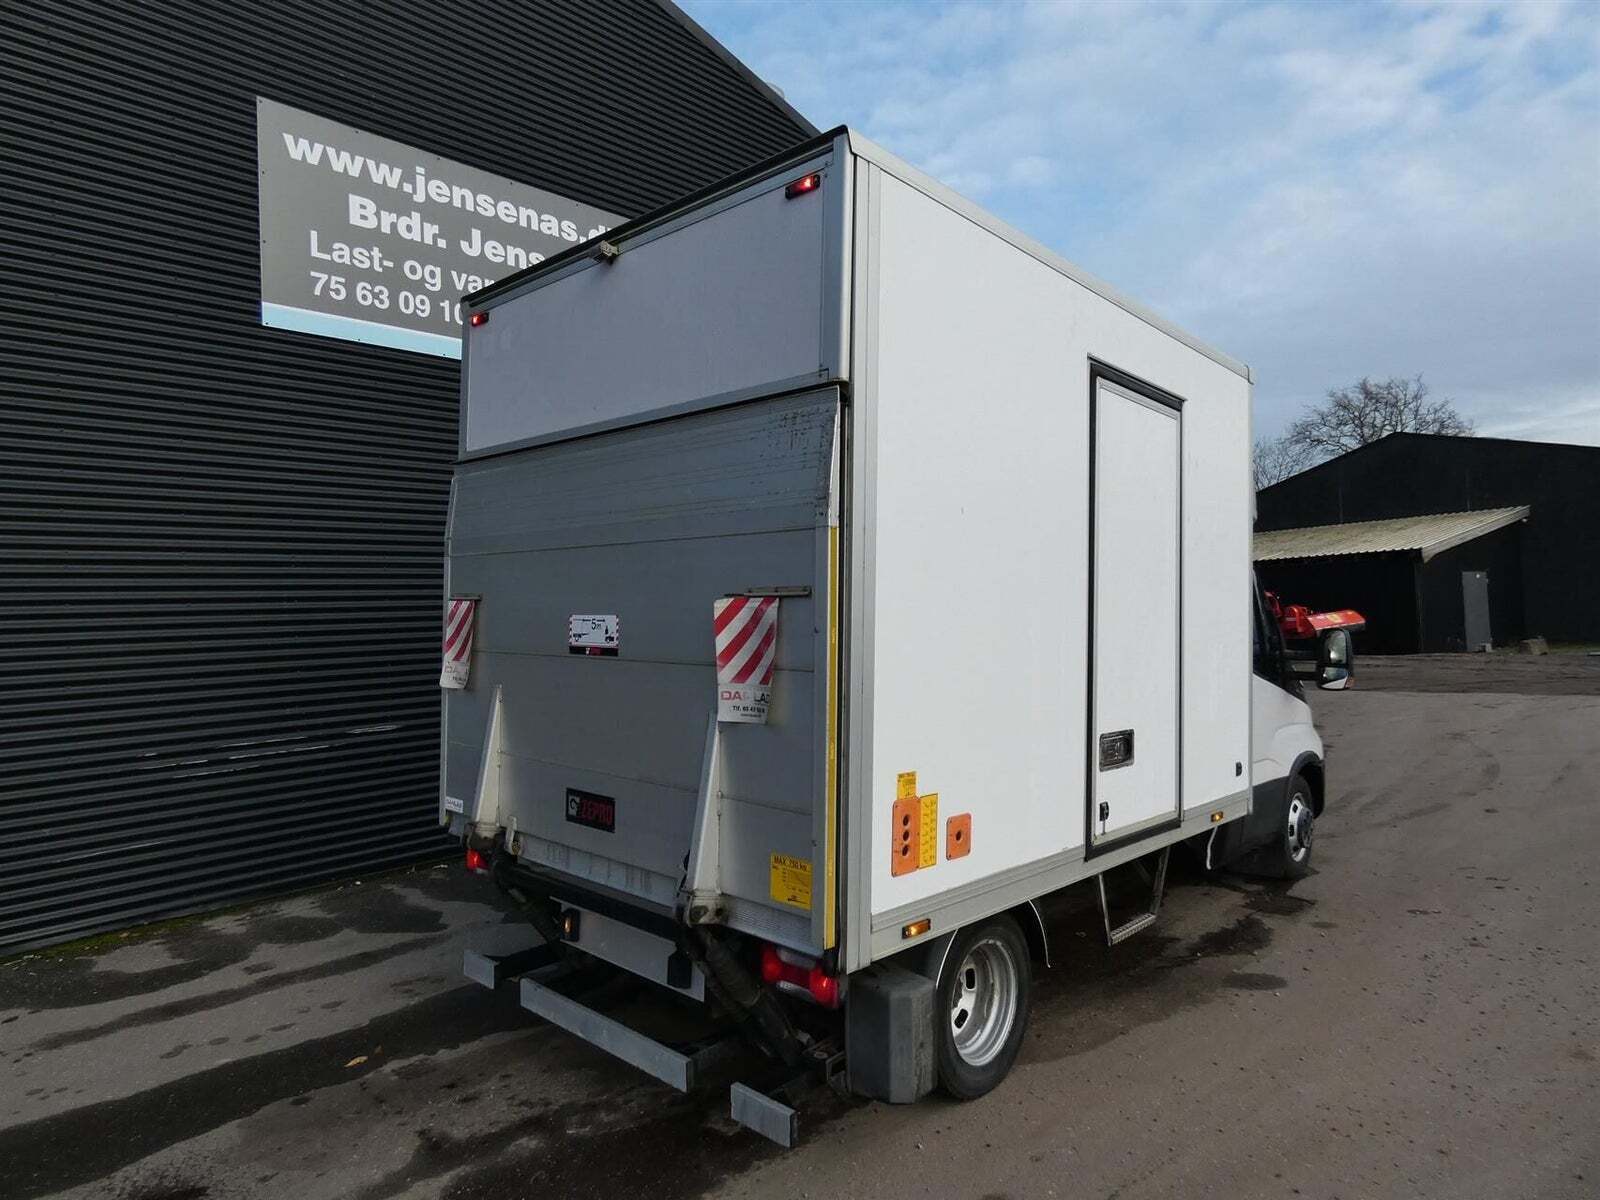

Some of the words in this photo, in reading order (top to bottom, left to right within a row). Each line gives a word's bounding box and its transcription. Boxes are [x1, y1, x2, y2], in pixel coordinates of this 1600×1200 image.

[348, 193, 447, 249] Brdr.
[310, 230, 394, 272] Last-
[403, 260, 441, 291] og
[310, 271, 346, 300] 75
[356, 282, 390, 309] 63
[398, 291, 430, 317] 09
